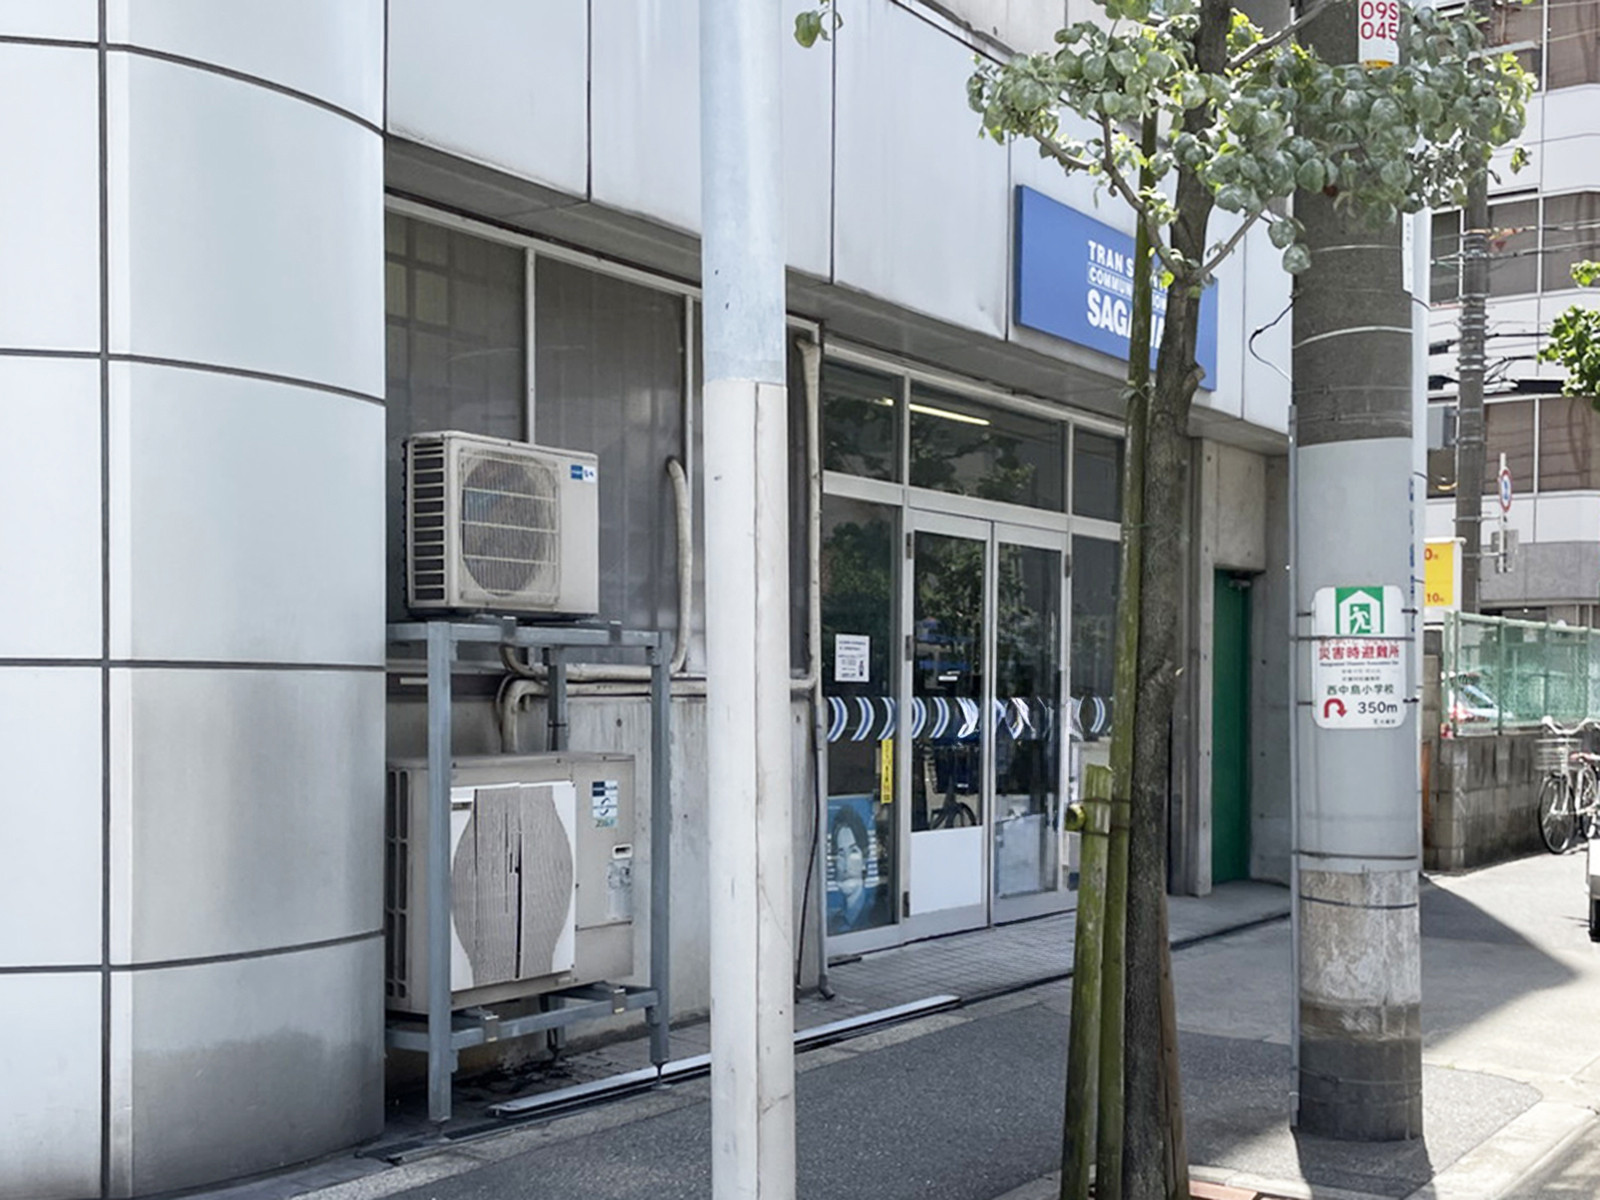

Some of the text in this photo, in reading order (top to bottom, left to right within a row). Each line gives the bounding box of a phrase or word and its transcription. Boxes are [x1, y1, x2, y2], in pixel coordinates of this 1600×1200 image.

[1360, 1, 1399, 21] 09S
[1360, 22, 1398, 40] 045
[1319, 645, 1399, 660] 災害時避難所
[1326, 684, 1394, 696] 西中島小学校
[1358, 701, 1398, 714] 350m
